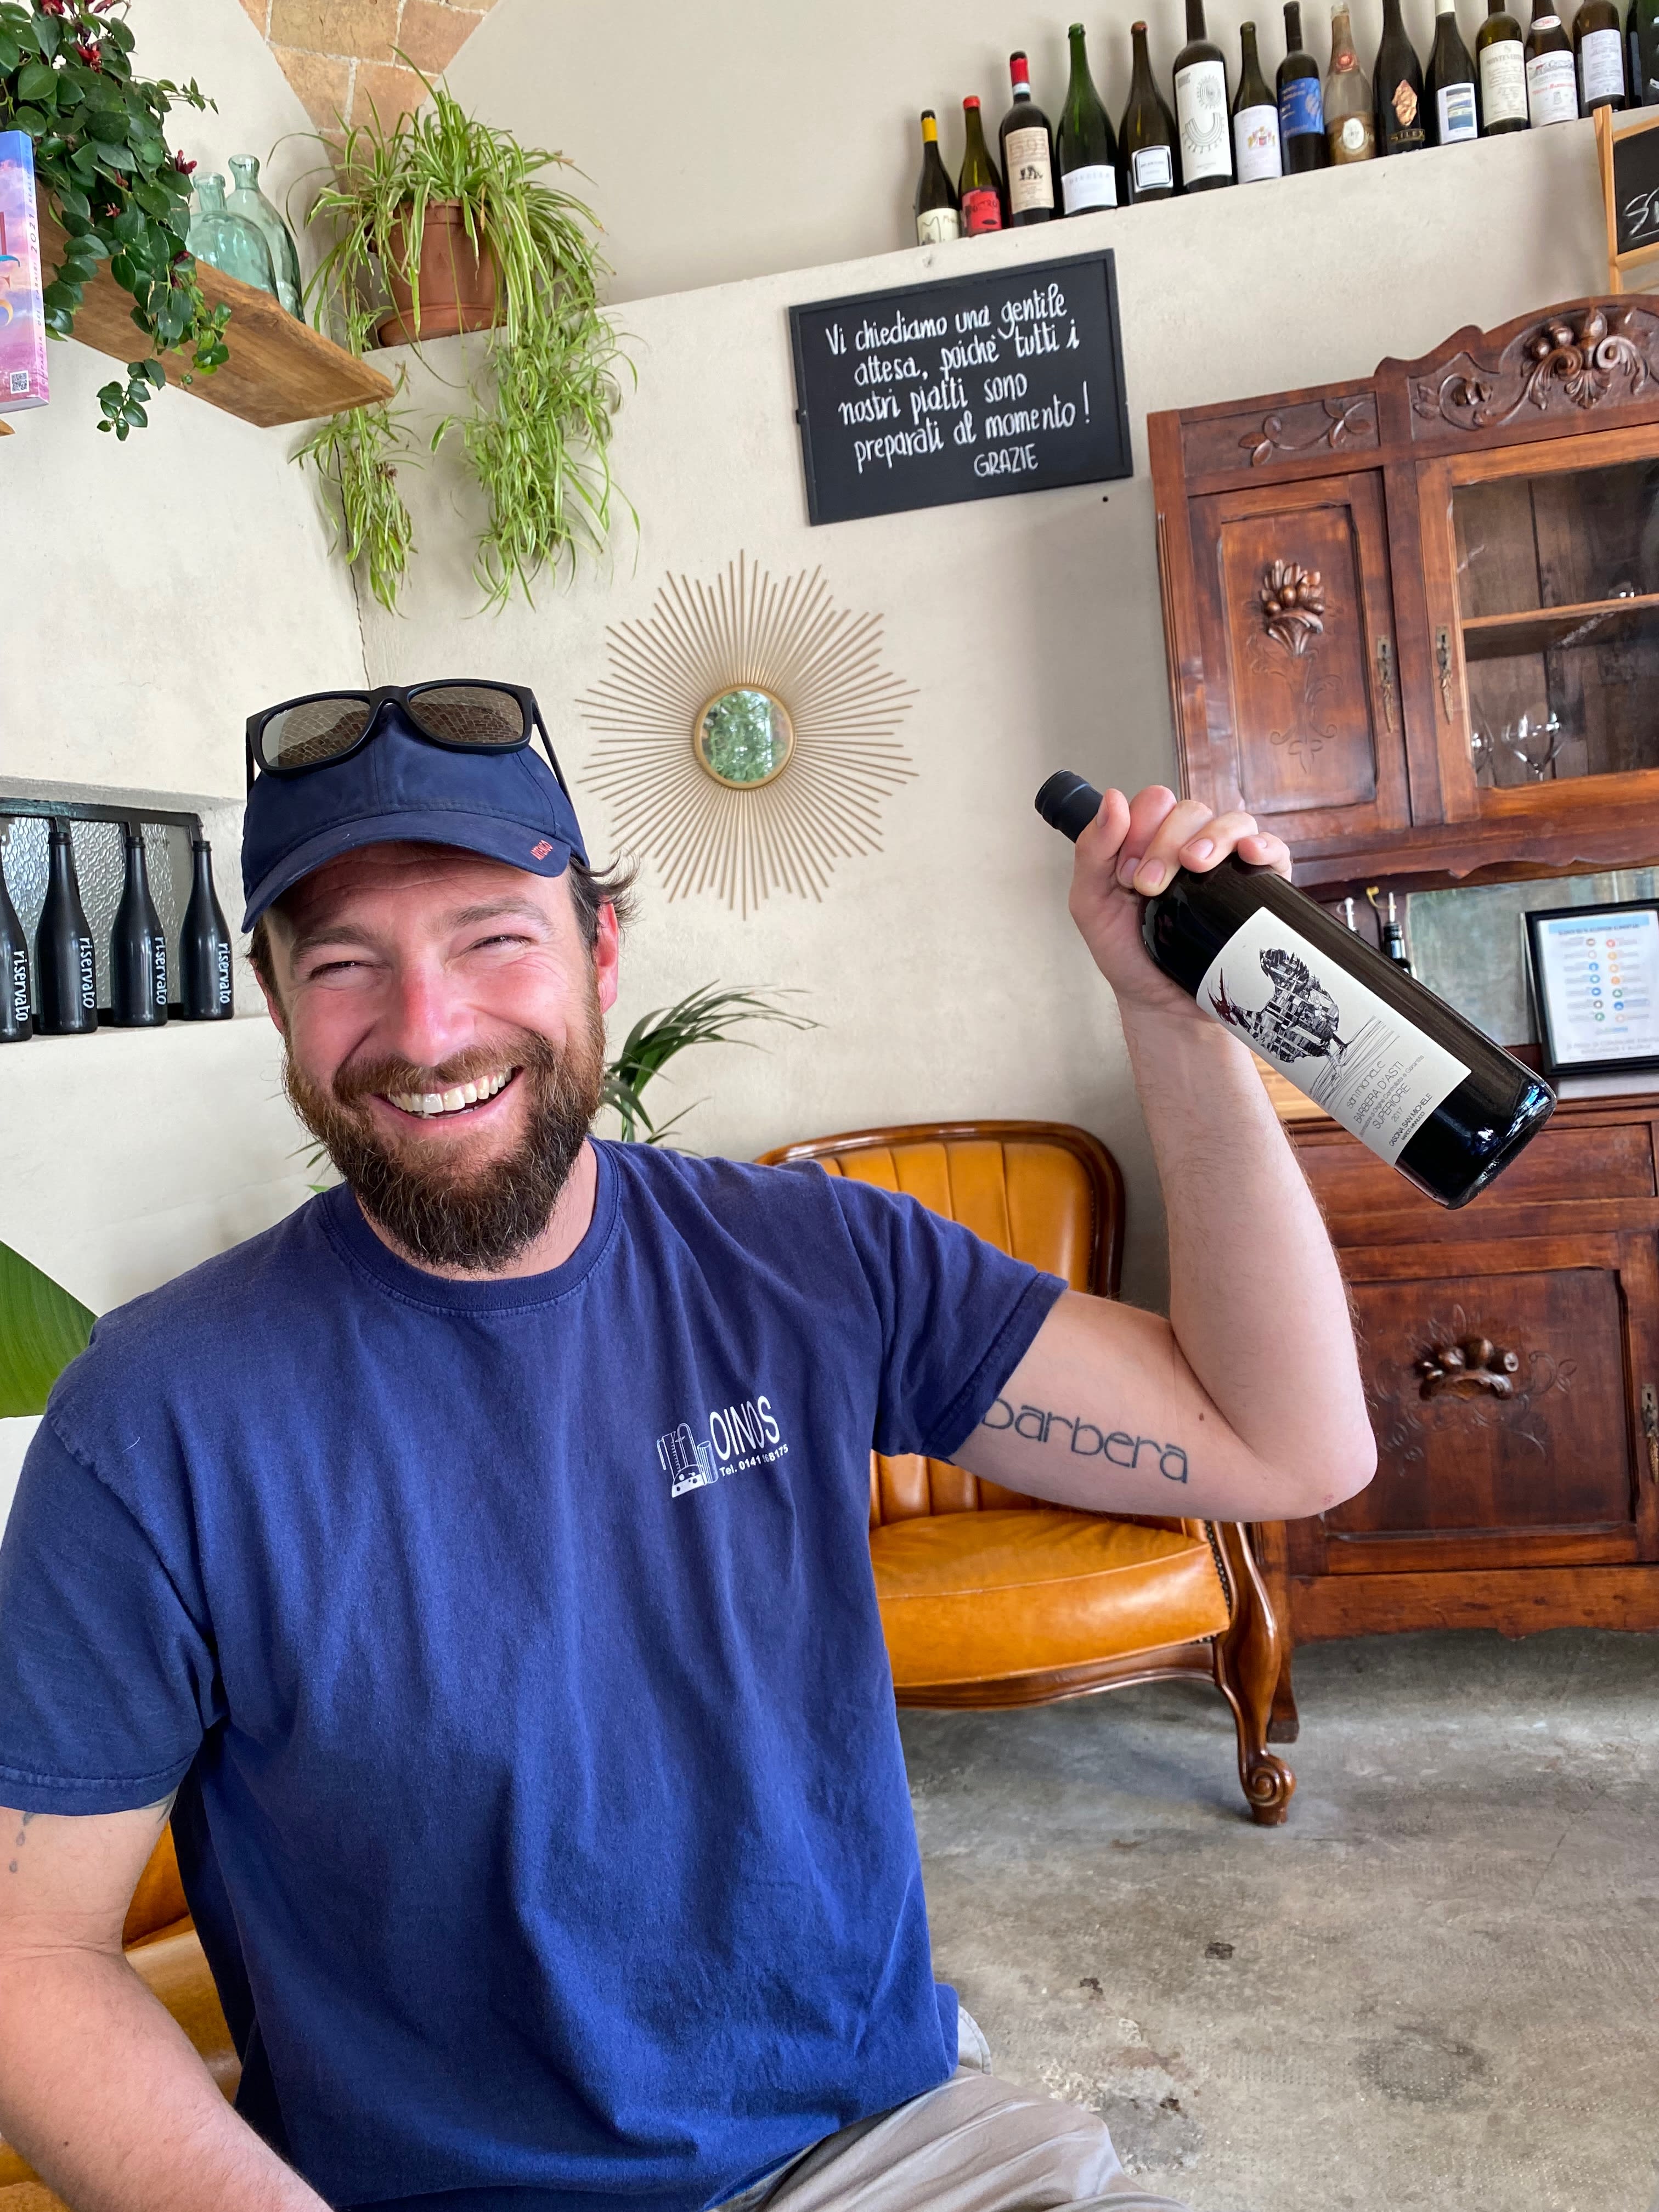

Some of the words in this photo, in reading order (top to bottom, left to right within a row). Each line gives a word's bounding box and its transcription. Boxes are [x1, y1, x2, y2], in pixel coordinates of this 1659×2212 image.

[28, 213, 37, 253] 2021
[826, 323, 847, 354] Vi
[855, 310, 947, 351] chiediamo
[955, 305, 991, 333] una
[997, 283, 1067, 340] gentile
[854, 355, 928, 387] attesa,
[1014, 321, 1060, 358] tutti
[1066, 318, 1080, 350] i
[838, 388, 901, 425] nostri
[910, 377, 968, 425] piatti
[984, 373, 1028, 403] sono
[854, 417, 944, 474] preparati
[953, 410, 977, 445] al
[985, 393, 1076, 440] momento
[973, 443, 1039, 477] GRAZIE
[13, 950, 29, 1022] riservato
[80, 937, 95, 1009] riservato
[155, 936, 167, 1005] riservato
[218, 943, 230, 1004] riservato
[1353, 1089, 1382, 1124] BARBERA
[1377, 1061, 1404, 1090] D'ASTI
[1372, 1082, 1411, 1129] SUPERIORE
[1391, 1106, 1404, 1123] 2017
[1402, 1115, 1413, 1128] SAN
[1410, 1093, 1433, 1117] MICHELE
[709, 1396, 780, 1460] OINOS
[719, 1464, 737, 1477] Tel.
[738, 1455, 761, 1470] 0141
